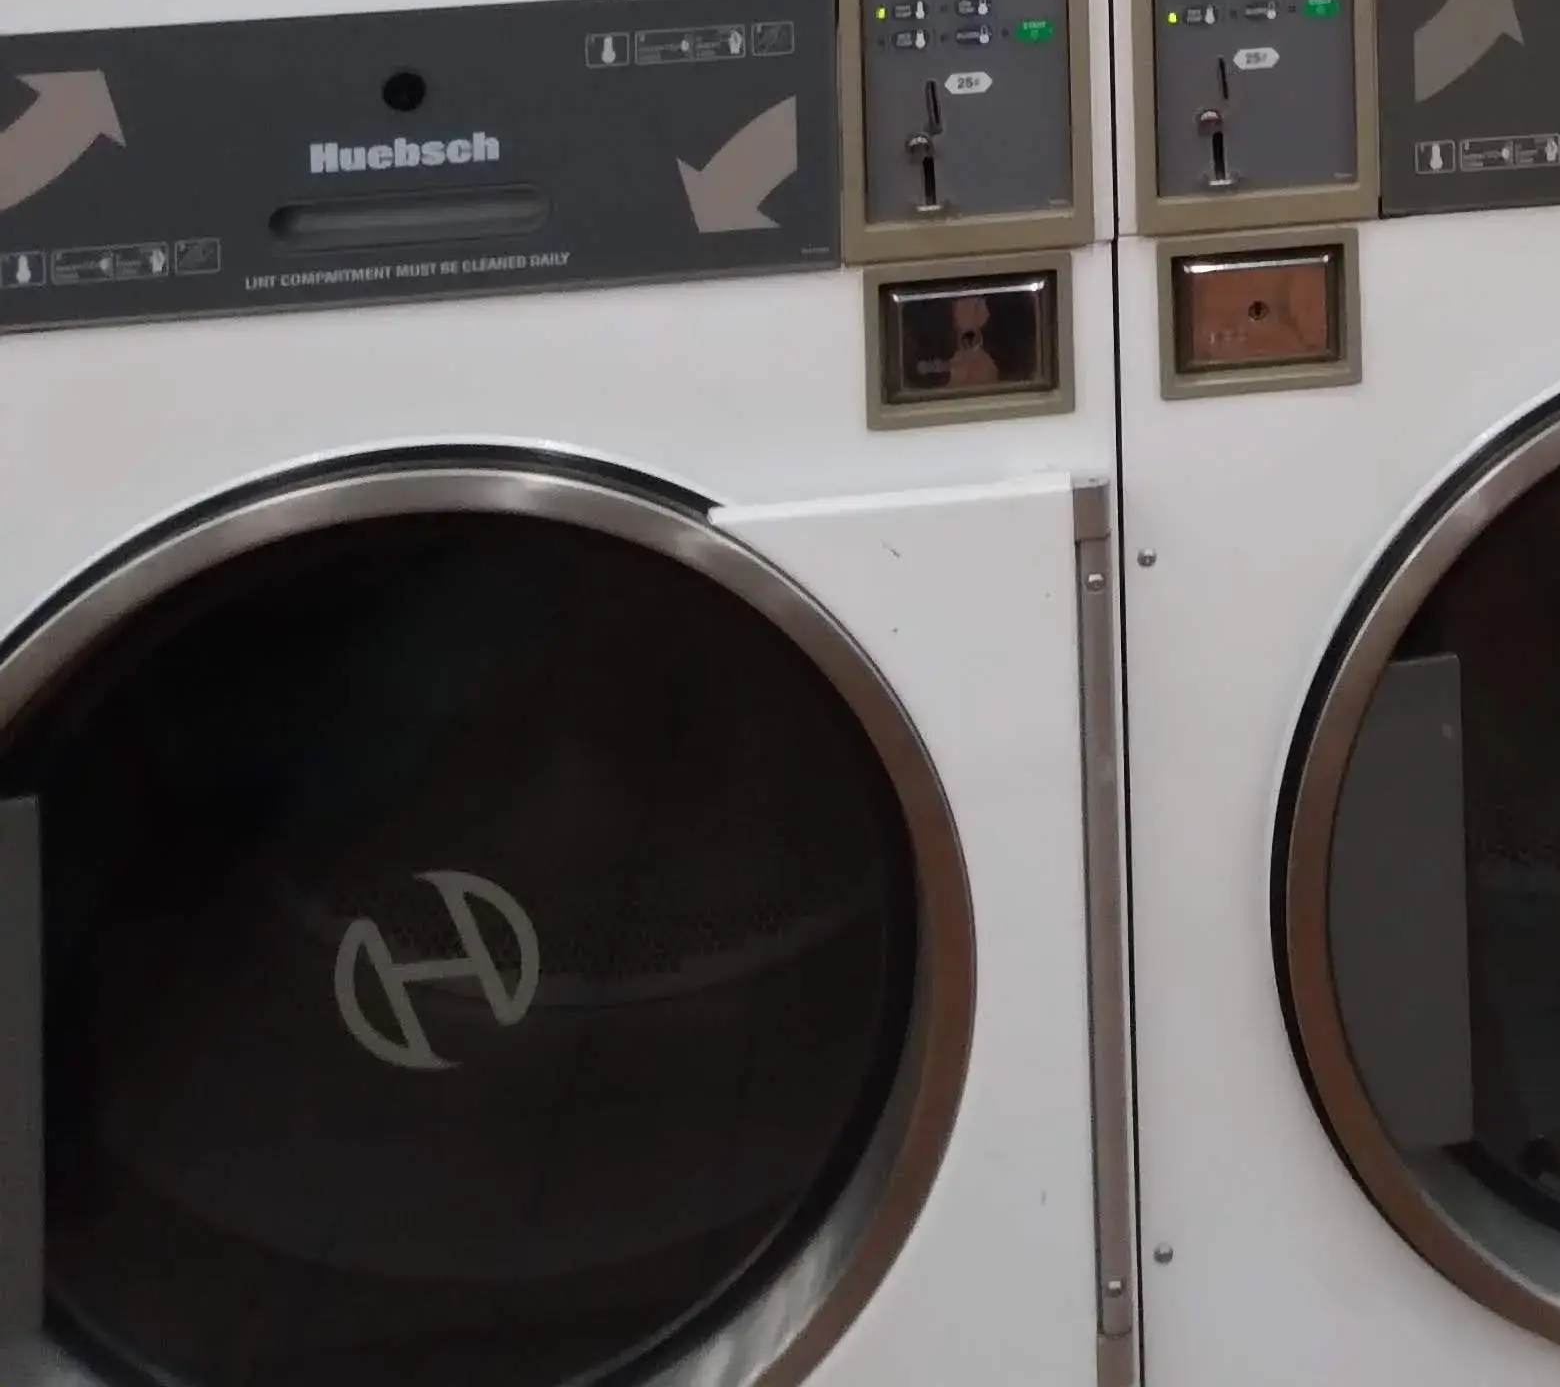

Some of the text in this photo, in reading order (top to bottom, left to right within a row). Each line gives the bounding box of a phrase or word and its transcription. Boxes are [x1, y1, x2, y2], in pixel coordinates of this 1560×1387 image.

[309, 131, 501, 174] Huebsch
[280, 266, 392, 288] COMPARTMENT
[396, 262, 437, 278] MUST
[440, 260, 459, 275] BE
[462, 256, 527, 273] CLEANED
